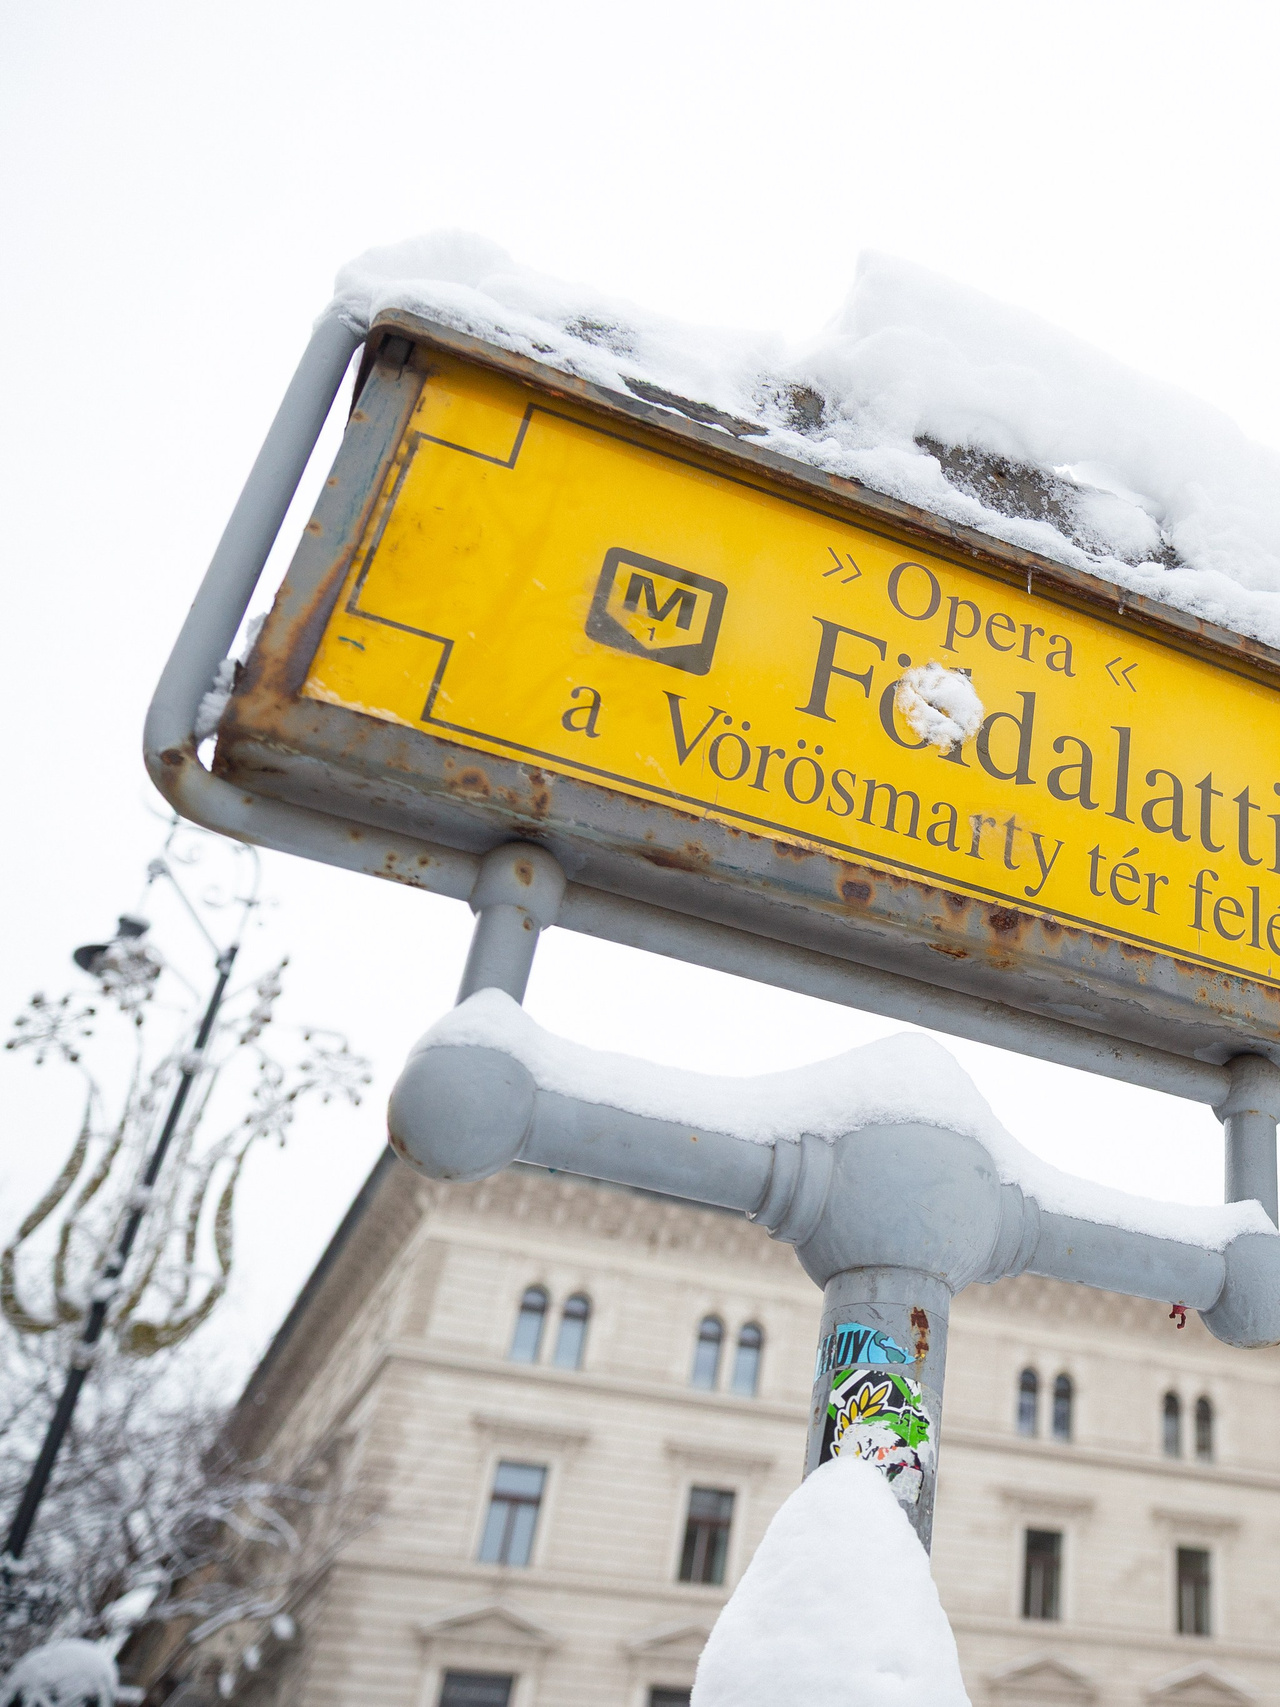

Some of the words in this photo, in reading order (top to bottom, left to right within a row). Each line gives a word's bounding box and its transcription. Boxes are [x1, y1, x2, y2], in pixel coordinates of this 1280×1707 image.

[887, 561, 1076, 678] Opera
[561, 686, 602, 739] a
[662, 690, 1065, 898] Vörösmarty
[1087, 843, 1169, 916] tér
